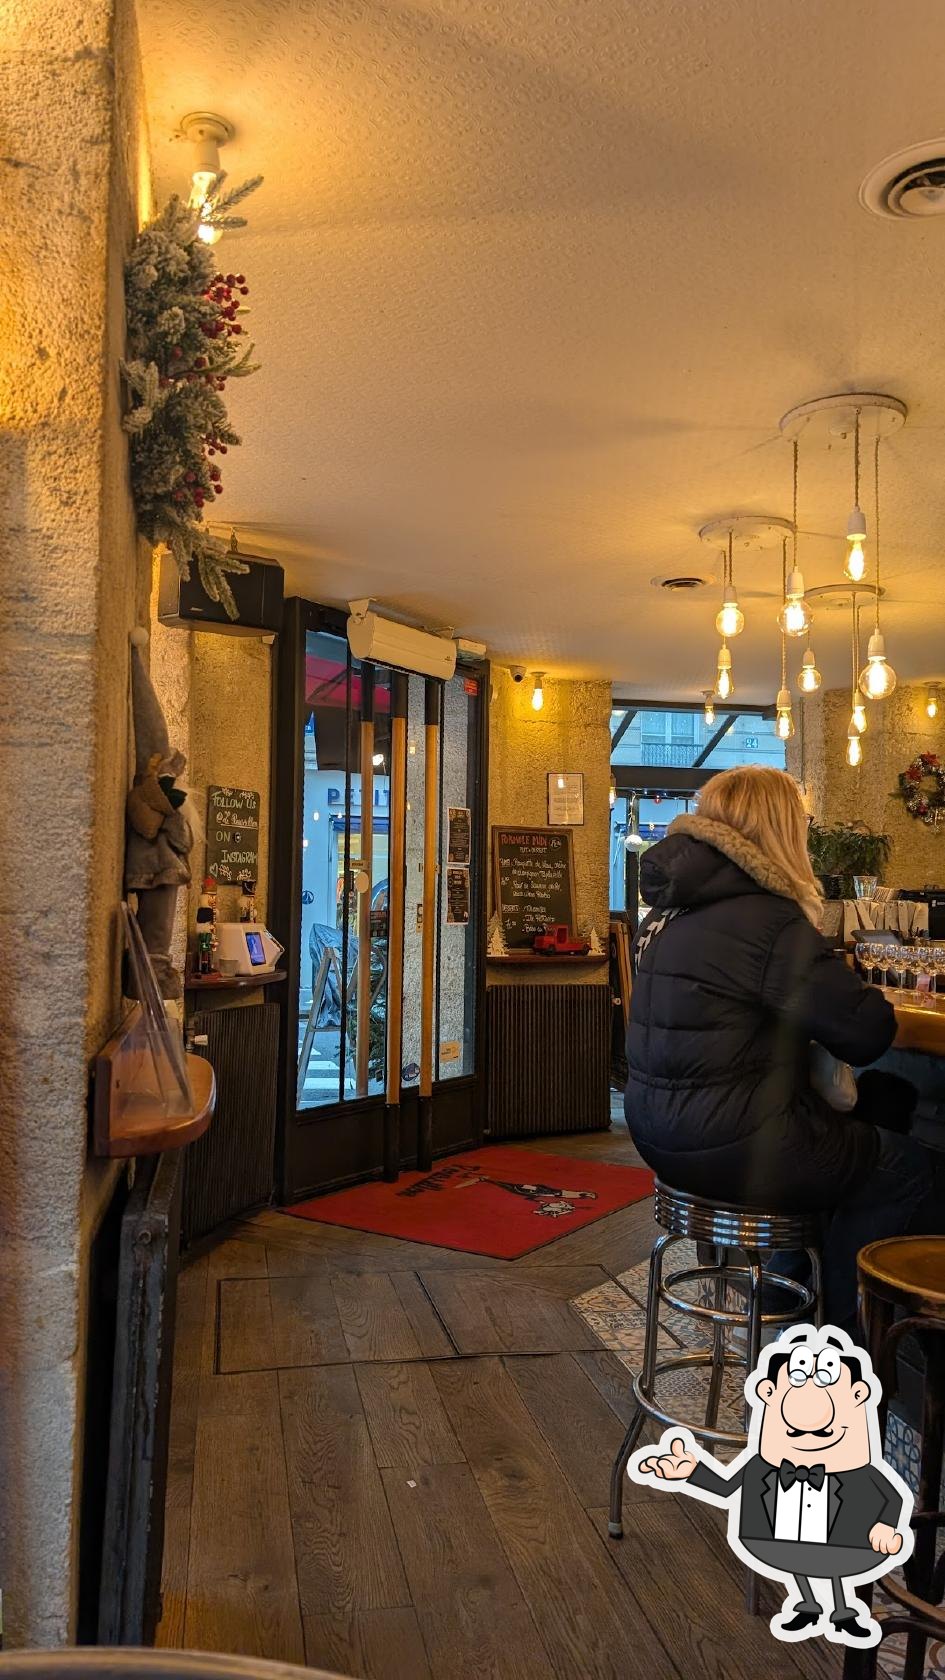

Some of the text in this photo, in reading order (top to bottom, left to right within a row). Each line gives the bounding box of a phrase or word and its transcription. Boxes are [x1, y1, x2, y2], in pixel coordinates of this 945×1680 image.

[211, 791, 243, 809] FOLLOW
[216, 830, 231, 842] ON
[221, 849, 258, 864] INSTAGRAM
